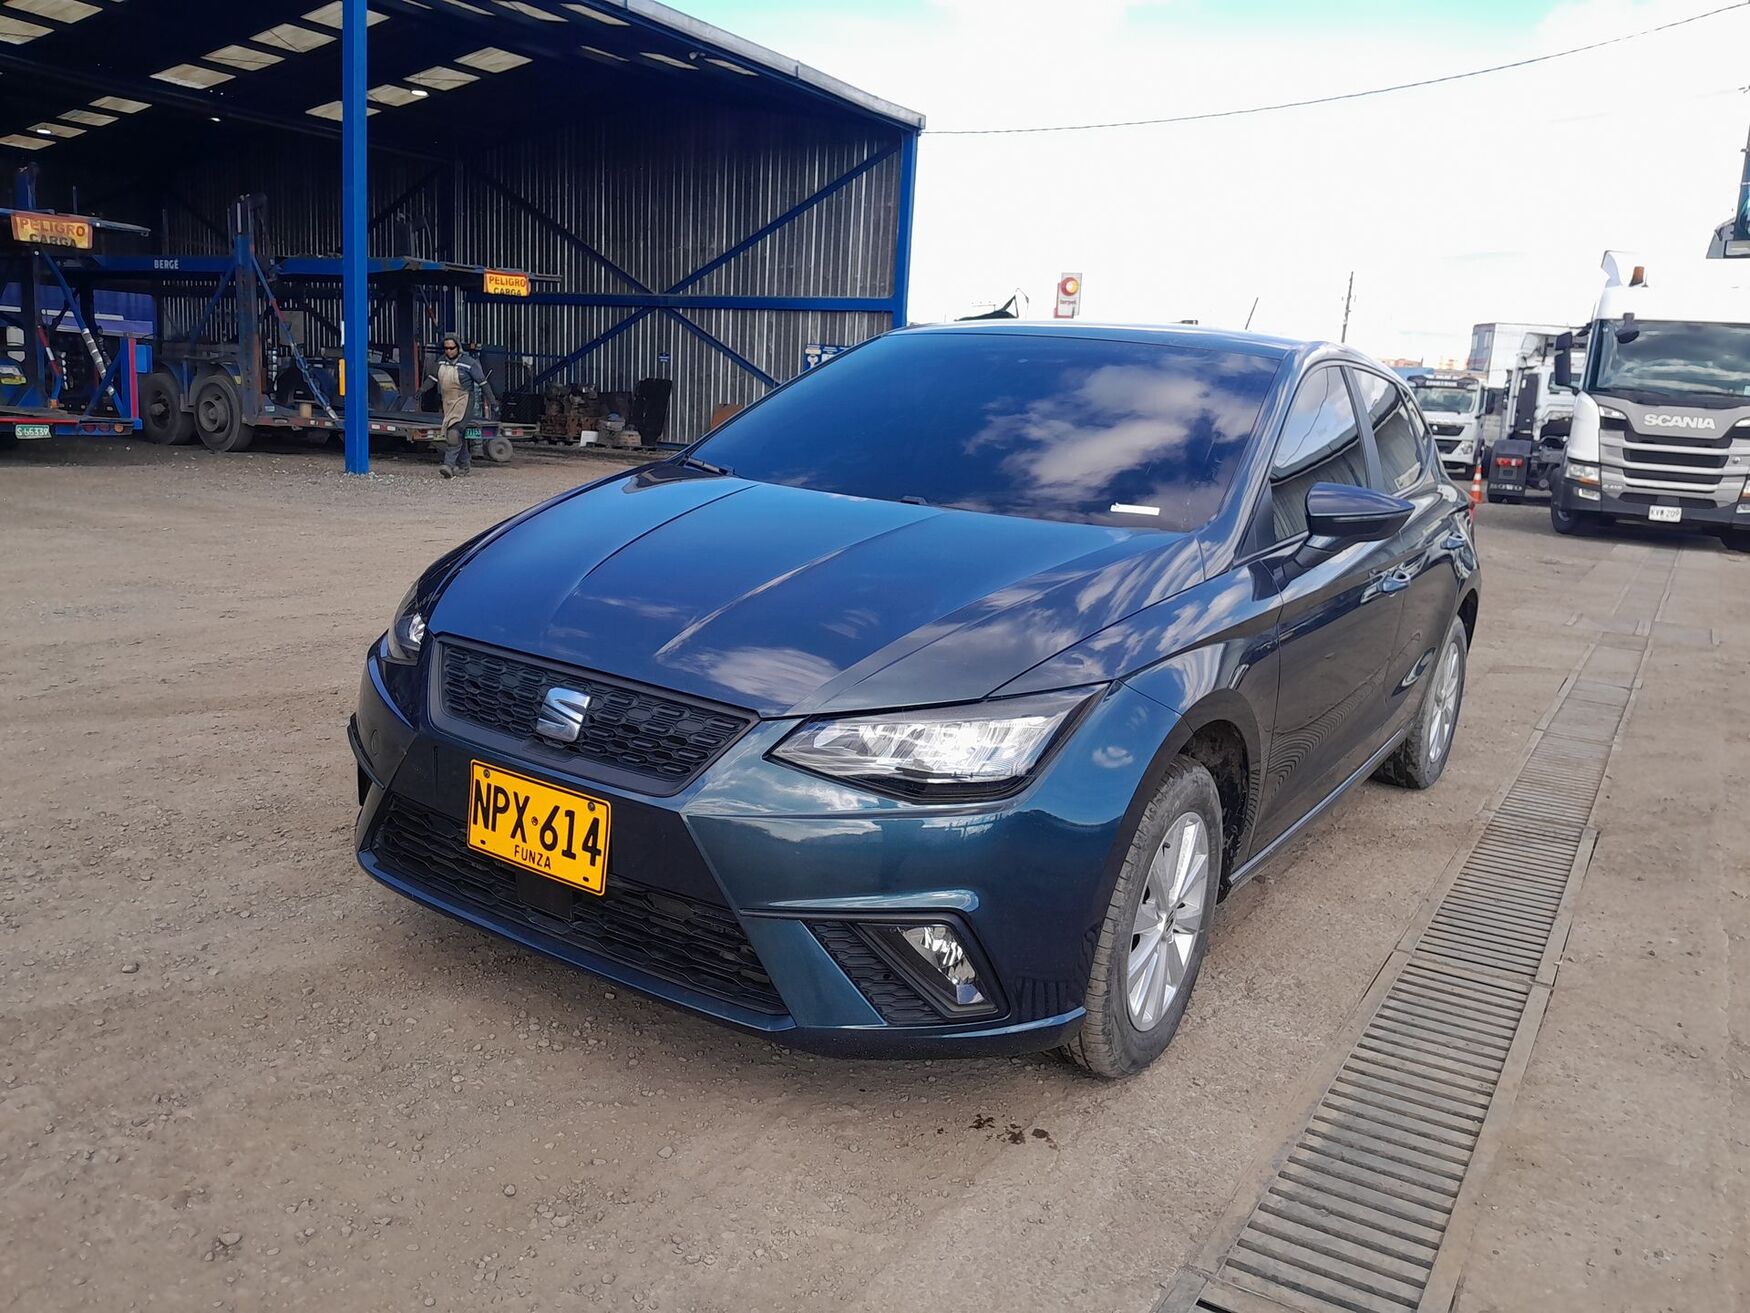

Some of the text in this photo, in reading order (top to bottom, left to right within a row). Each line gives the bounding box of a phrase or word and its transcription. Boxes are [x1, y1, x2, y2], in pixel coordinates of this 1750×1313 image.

[20, 219, 85, 237] PELIGRO
[489, 275, 526, 288] PELIGRO
[1644, 413, 1716, 429] SCANIA
[472, 778, 602, 868] NPX 614
[513, 844, 552, 871] FUNZA
